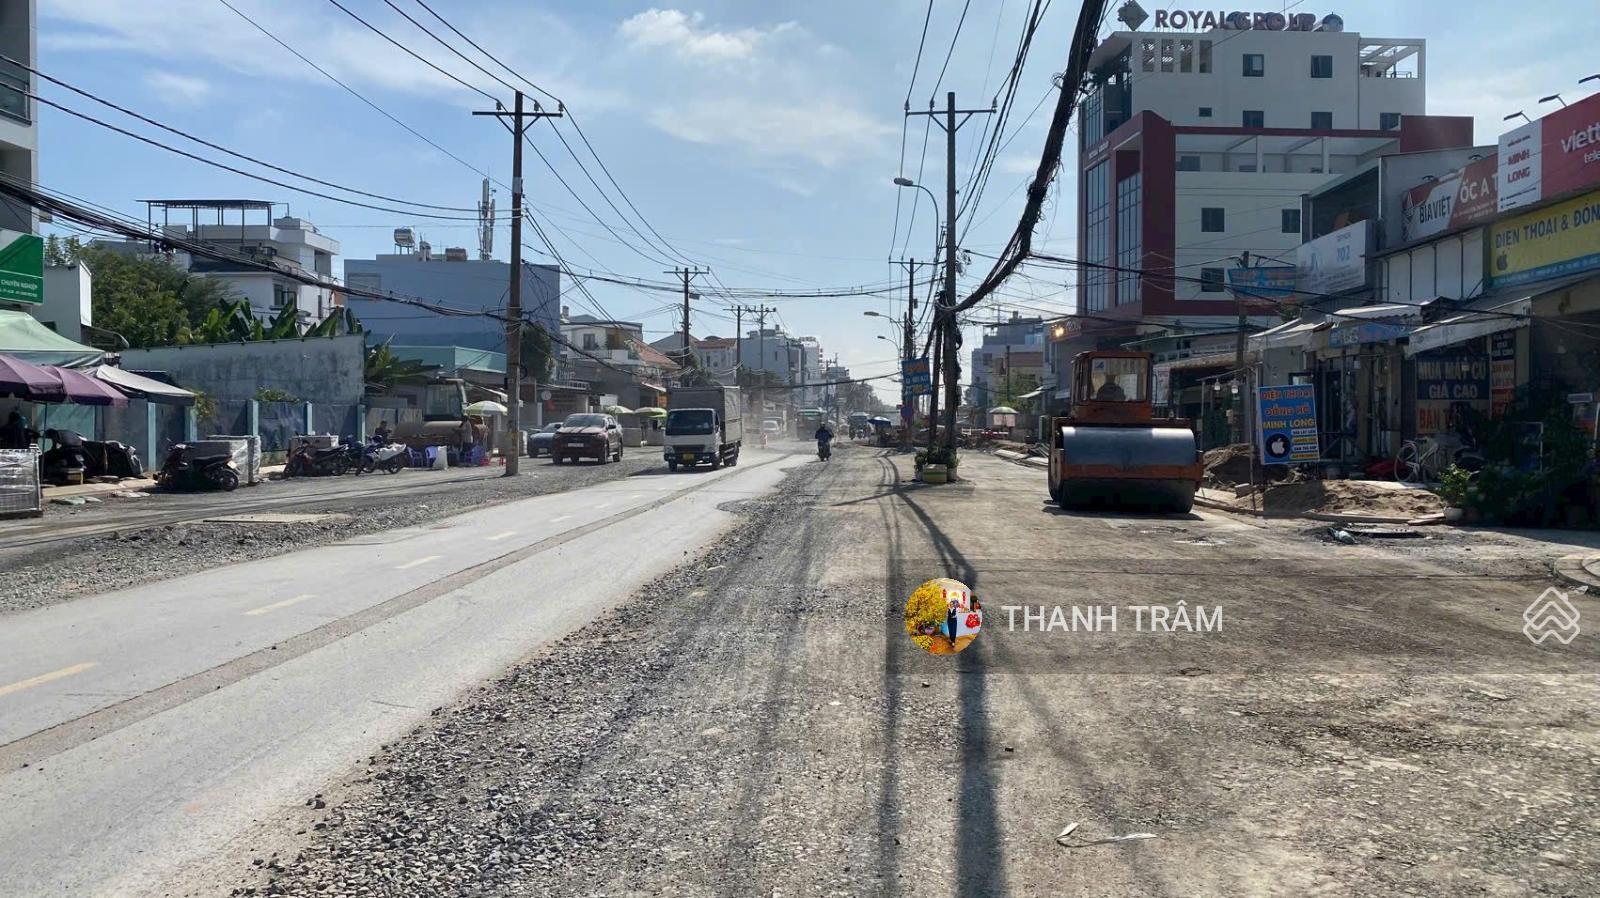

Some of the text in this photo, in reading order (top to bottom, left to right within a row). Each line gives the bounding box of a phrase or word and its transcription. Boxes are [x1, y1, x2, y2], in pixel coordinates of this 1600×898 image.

[1154, 9, 1228, 30] ROYAL
[1507, 148, 1530, 166] MINH
[1507, 166, 1531, 184] LONG
[1480, 177, 1490, 198] A
[1523, 216, 1558, 241] THOẠI
[1560, 213, 1569, 231] &
[1417, 361, 1441, 380] MUA
[1428, 381, 1478, 398] GIÁ CAO
[1263, 418, 1315, 430] MINH LONG
